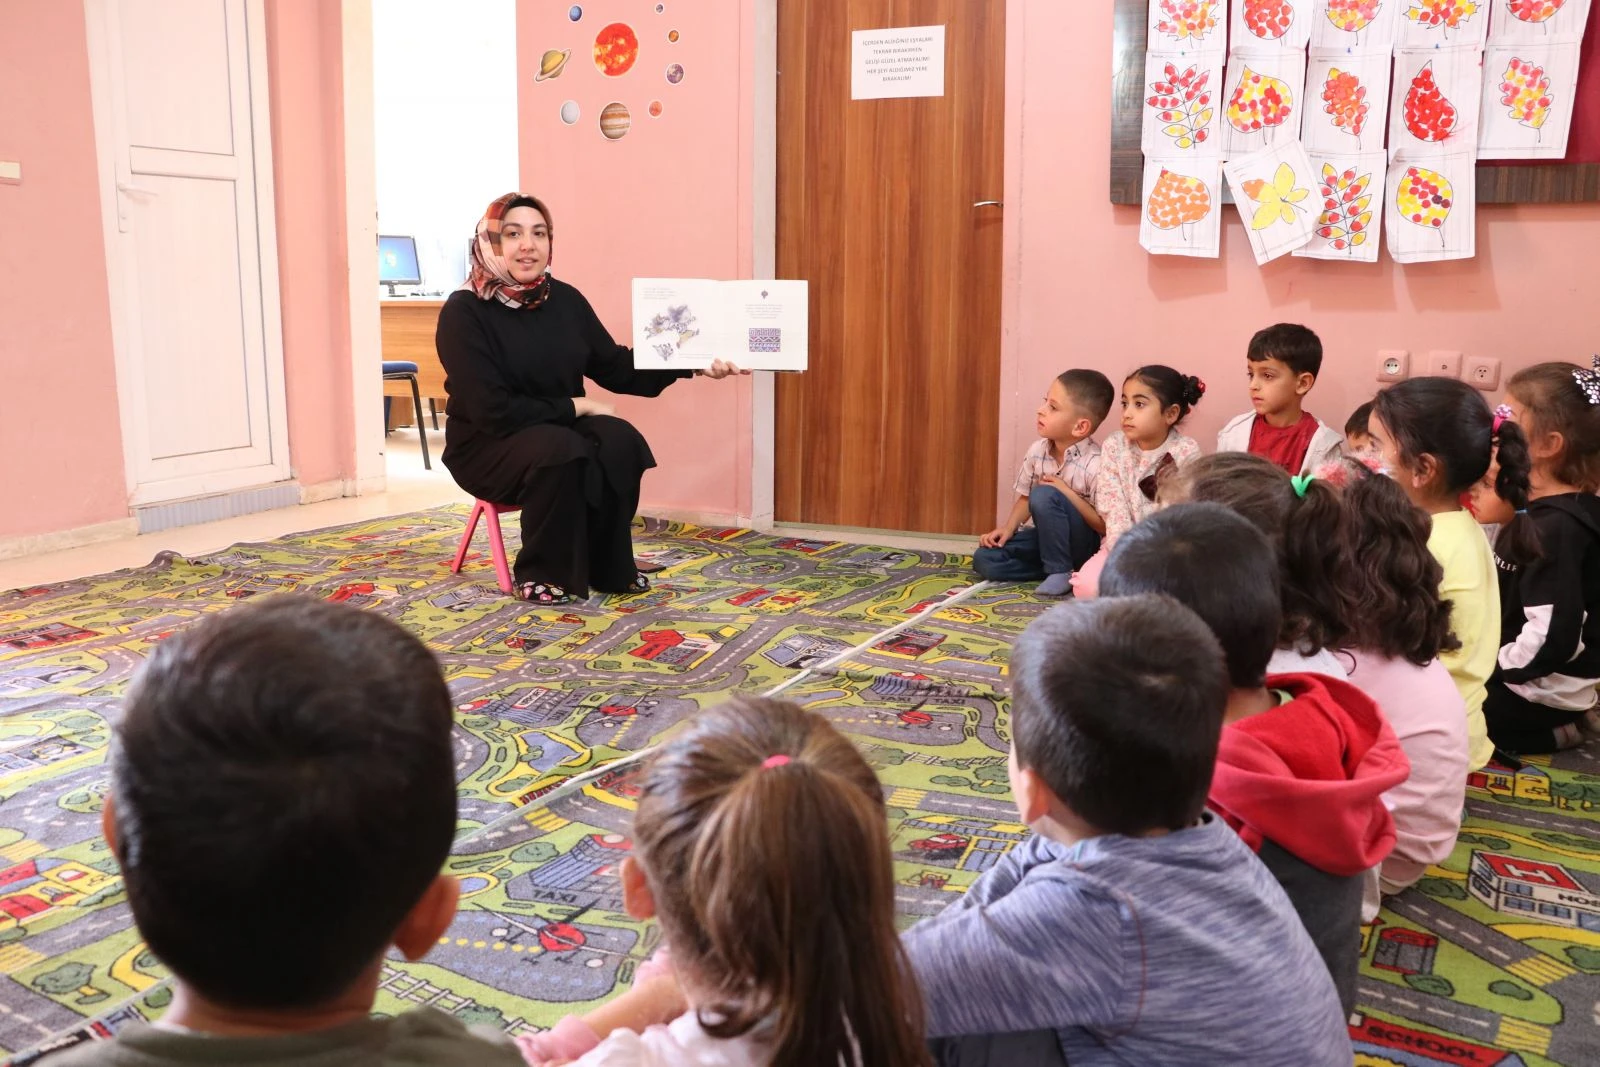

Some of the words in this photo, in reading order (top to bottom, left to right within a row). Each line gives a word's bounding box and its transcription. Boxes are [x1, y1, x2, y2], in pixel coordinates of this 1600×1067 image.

[1504, 863, 1555, 883] H
[533, 890, 578, 903] TAXI
[1367, 1026, 1485, 1062] SCHOOL
